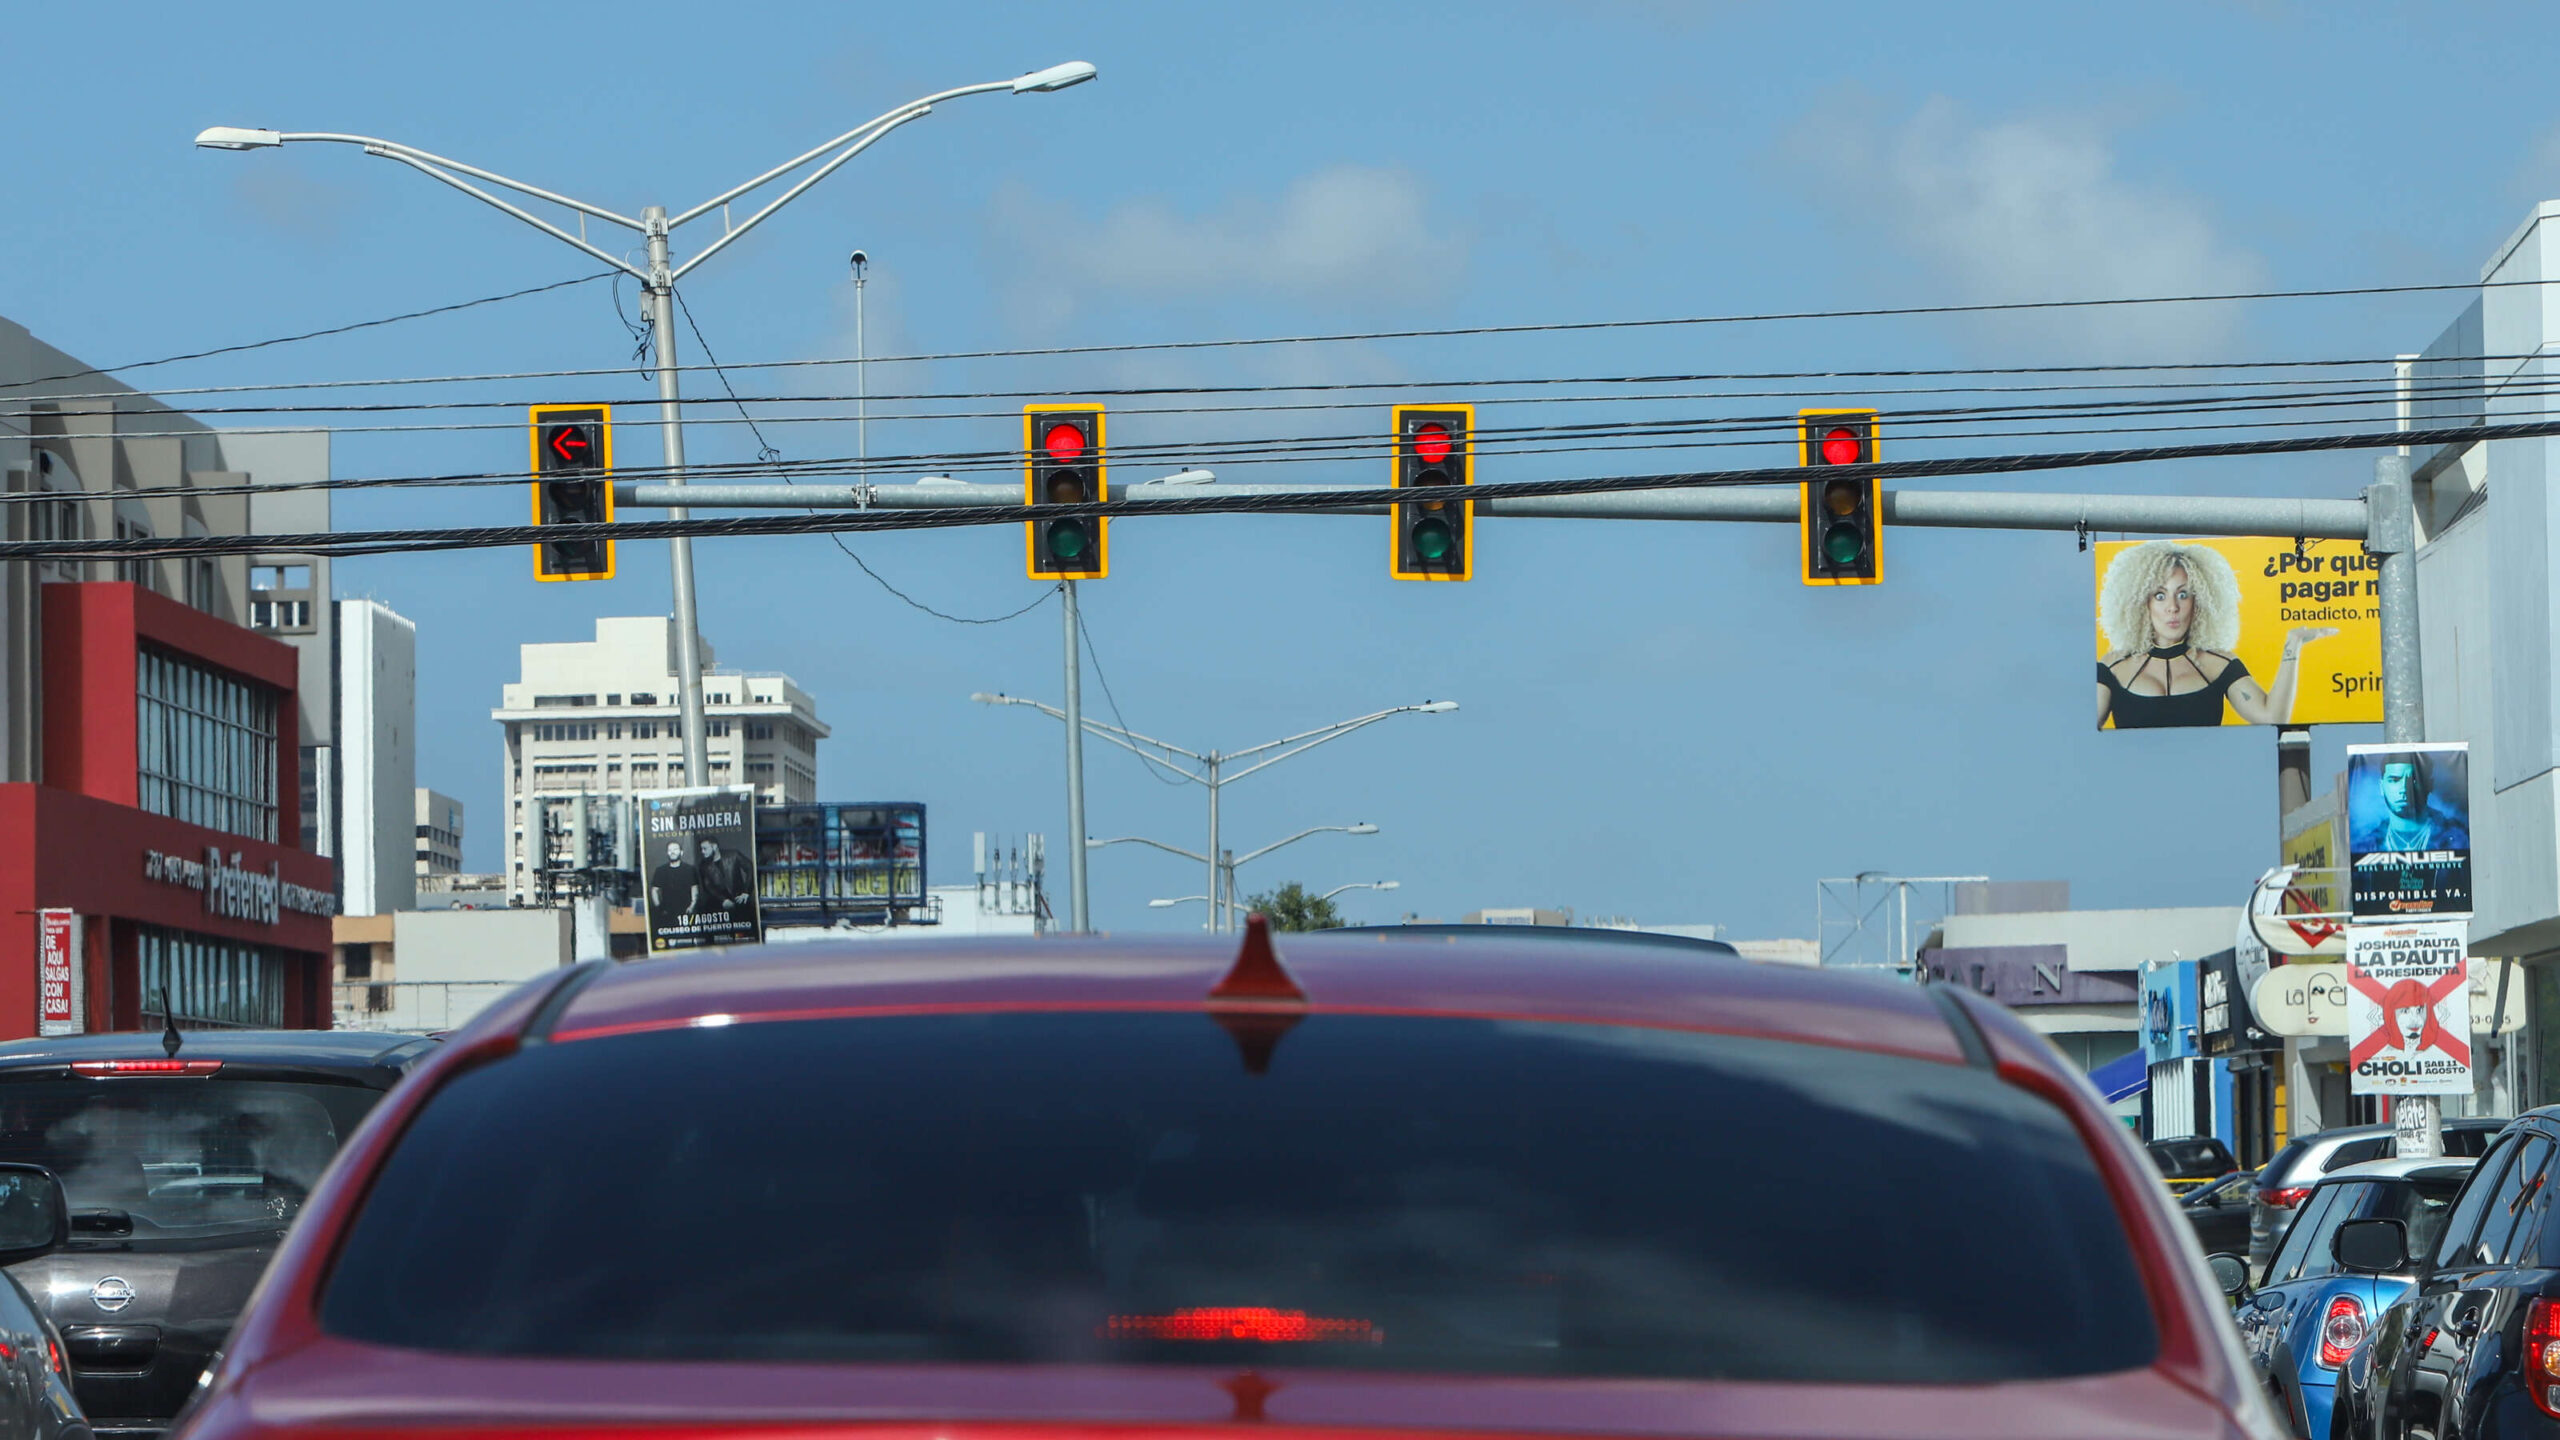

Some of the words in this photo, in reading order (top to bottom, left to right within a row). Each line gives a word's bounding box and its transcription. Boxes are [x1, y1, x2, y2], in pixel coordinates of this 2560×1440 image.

[2264, 553, 2324, 577] ¿Por
[2281, 580, 2359, 603] pagar
[2281, 607, 2361, 621] Datadicto,
[651, 816, 674, 832] SIN
[679, 811, 741, 830] BANDERA
[2384, 863, 2410, 871] HASTA
[2414, 862, 2424, 870] LA
[207, 847, 280, 925] Preferred
[2355, 889, 2437, 901] DISPONIBLE
[677, 911, 730, 926] 18/AGOSTO
[658, 926, 690, 935] COLISEO
[691, 925, 702, 933] DE
[703, 922, 732, 931] PUERTO
[45, 935, 56, 949] DE
[2354, 940, 2411, 951] JOSHUA
[2414, 938, 2460, 948] PAUTA
[2355, 951, 2385, 967] LA
[2391, 949, 2461, 966] PAUTI
[45, 966, 69, 982] SALGAS
[2355, 969, 2372, 978] LA
[2376, 966, 2460, 977] PRESIDENTA
[45, 982, 63, 997] CON
[46, 998, 68, 1014] CASA!
[2357, 1061, 2422, 1076] CHOLI
[2425, 1067, 2466, 1075] AGOSTO
